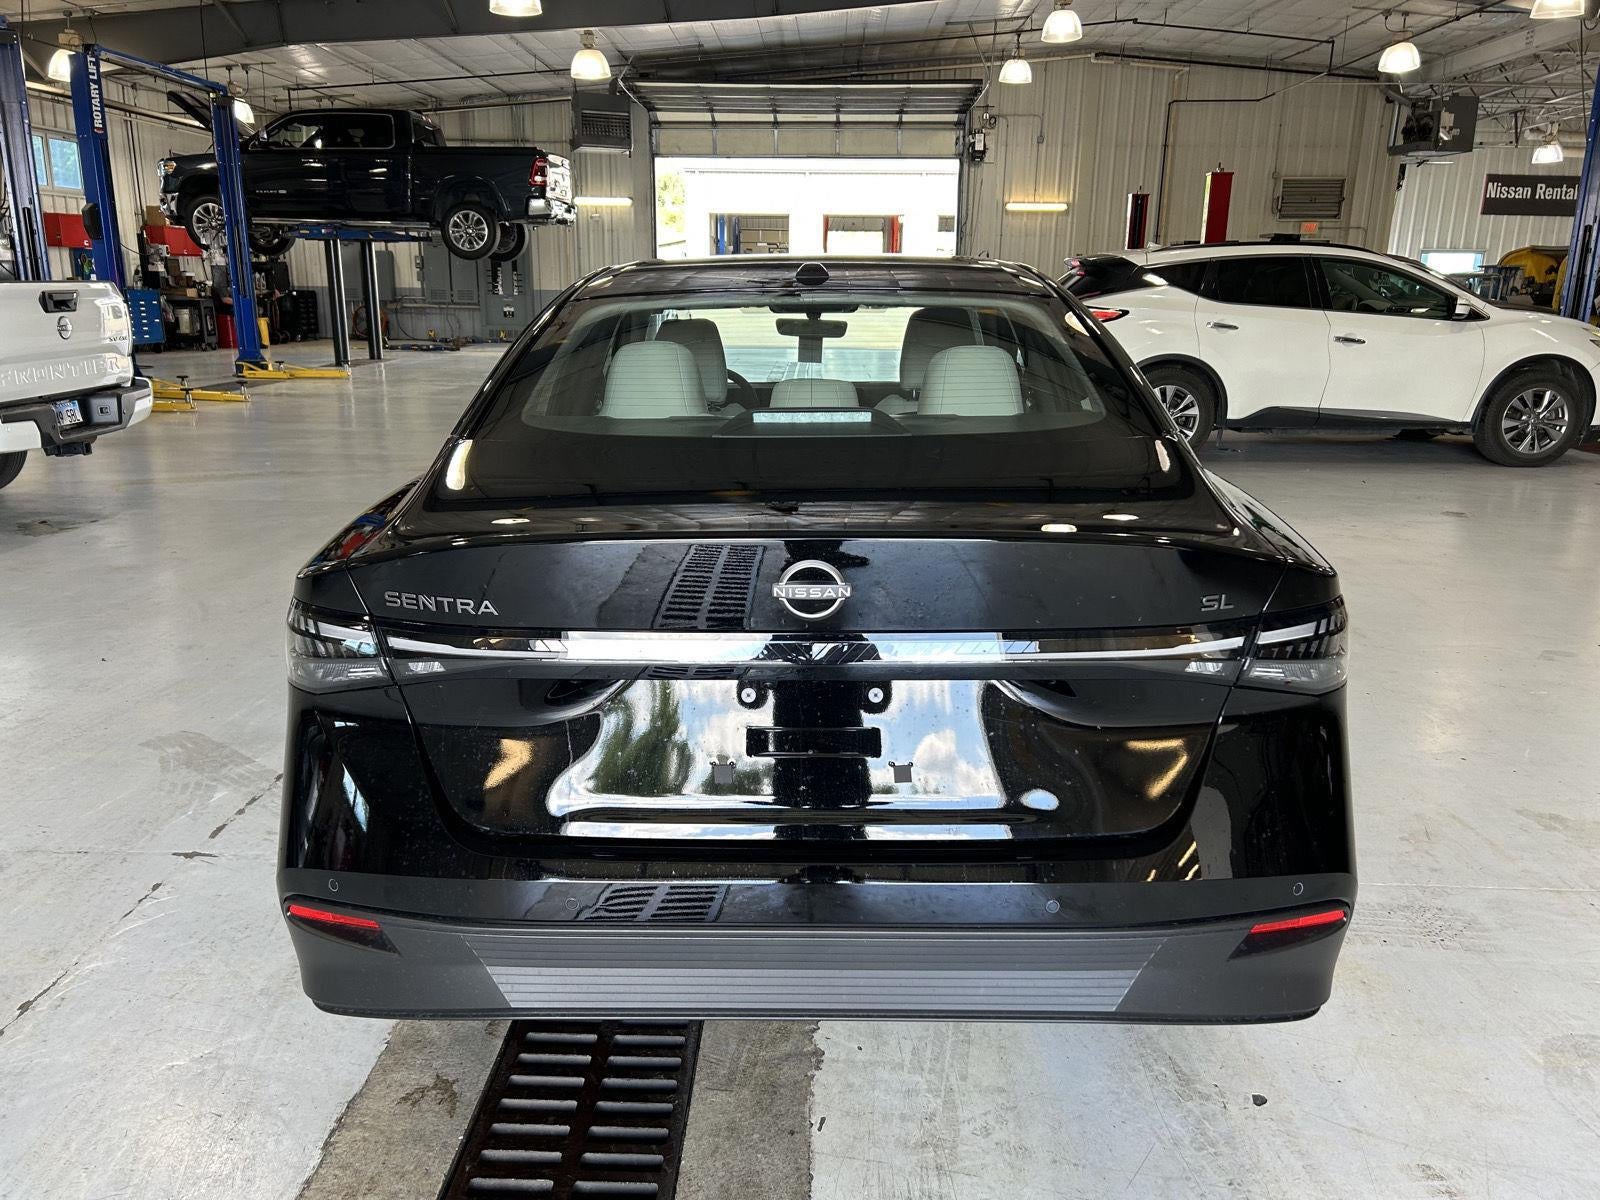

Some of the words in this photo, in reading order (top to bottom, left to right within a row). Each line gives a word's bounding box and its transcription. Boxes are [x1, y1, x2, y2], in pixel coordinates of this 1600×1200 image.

[87, 55, 97, 80] LIFT
[90, 82, 102, 128] ROTARY
[1486, 182, 1531, 199] Nissan
[1535, 183, 1579, 200] Rental
[773, 587, 851, 598] NISSAN
[1201, 594, 1235, 612] SL
[384, 591, 499, 616] SENTRA
